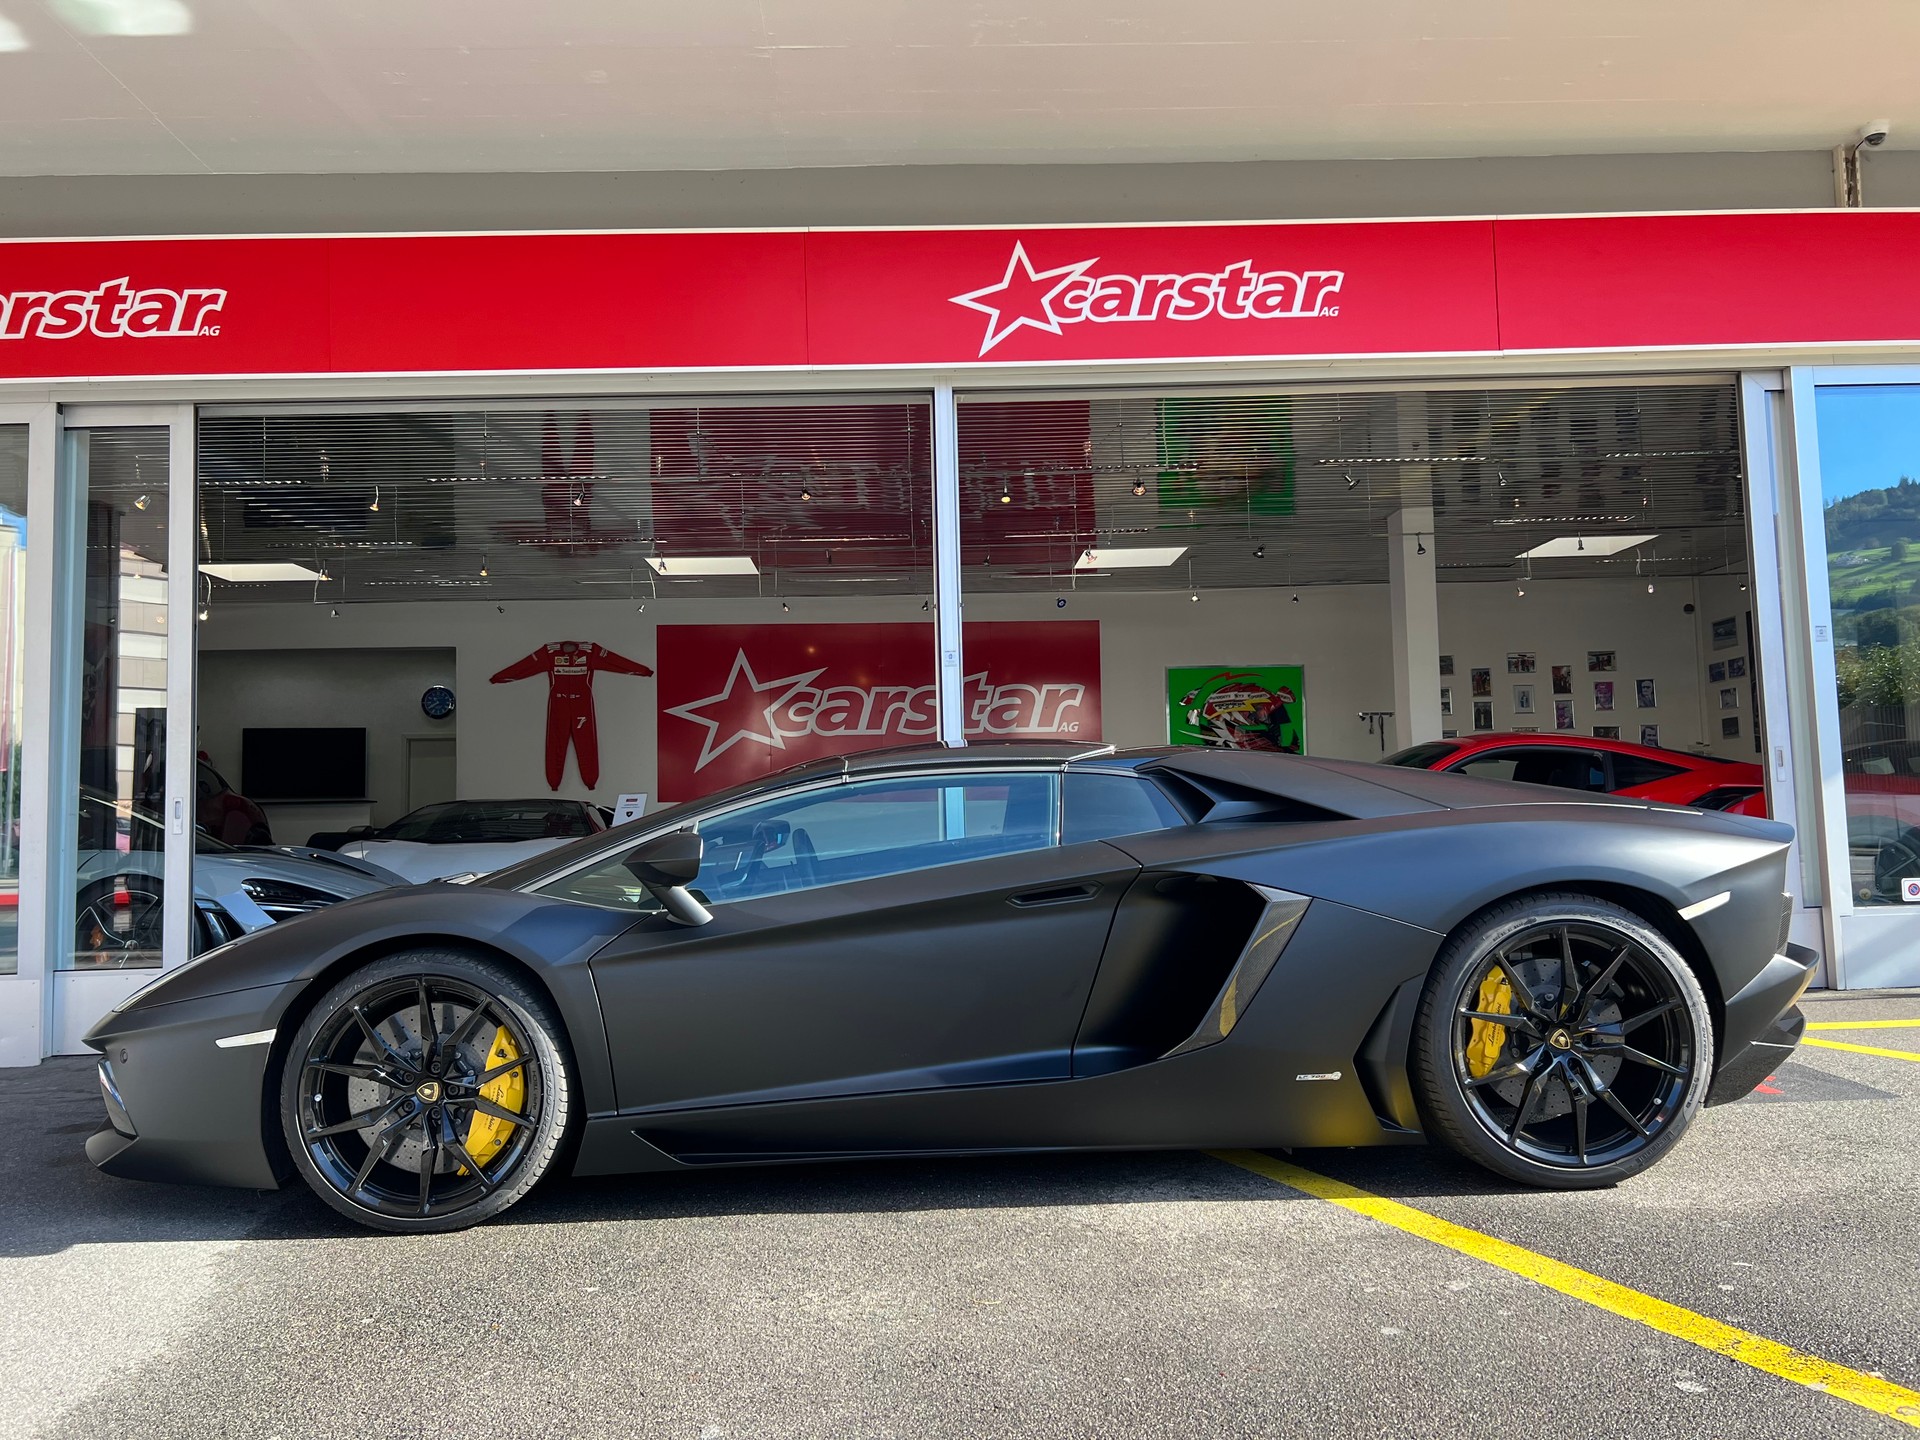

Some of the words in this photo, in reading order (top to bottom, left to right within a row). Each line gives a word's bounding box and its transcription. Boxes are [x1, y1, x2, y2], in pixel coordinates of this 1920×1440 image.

[0, 276, 228, 340] rstar
[199, 325, 221, 337] AG
[1049, 258, 1345, 323] carstar
[1319, 306, 1340, 317] AG
[576, 716, 587, 729] 7
[1058, 721, 1080, 733] AG
